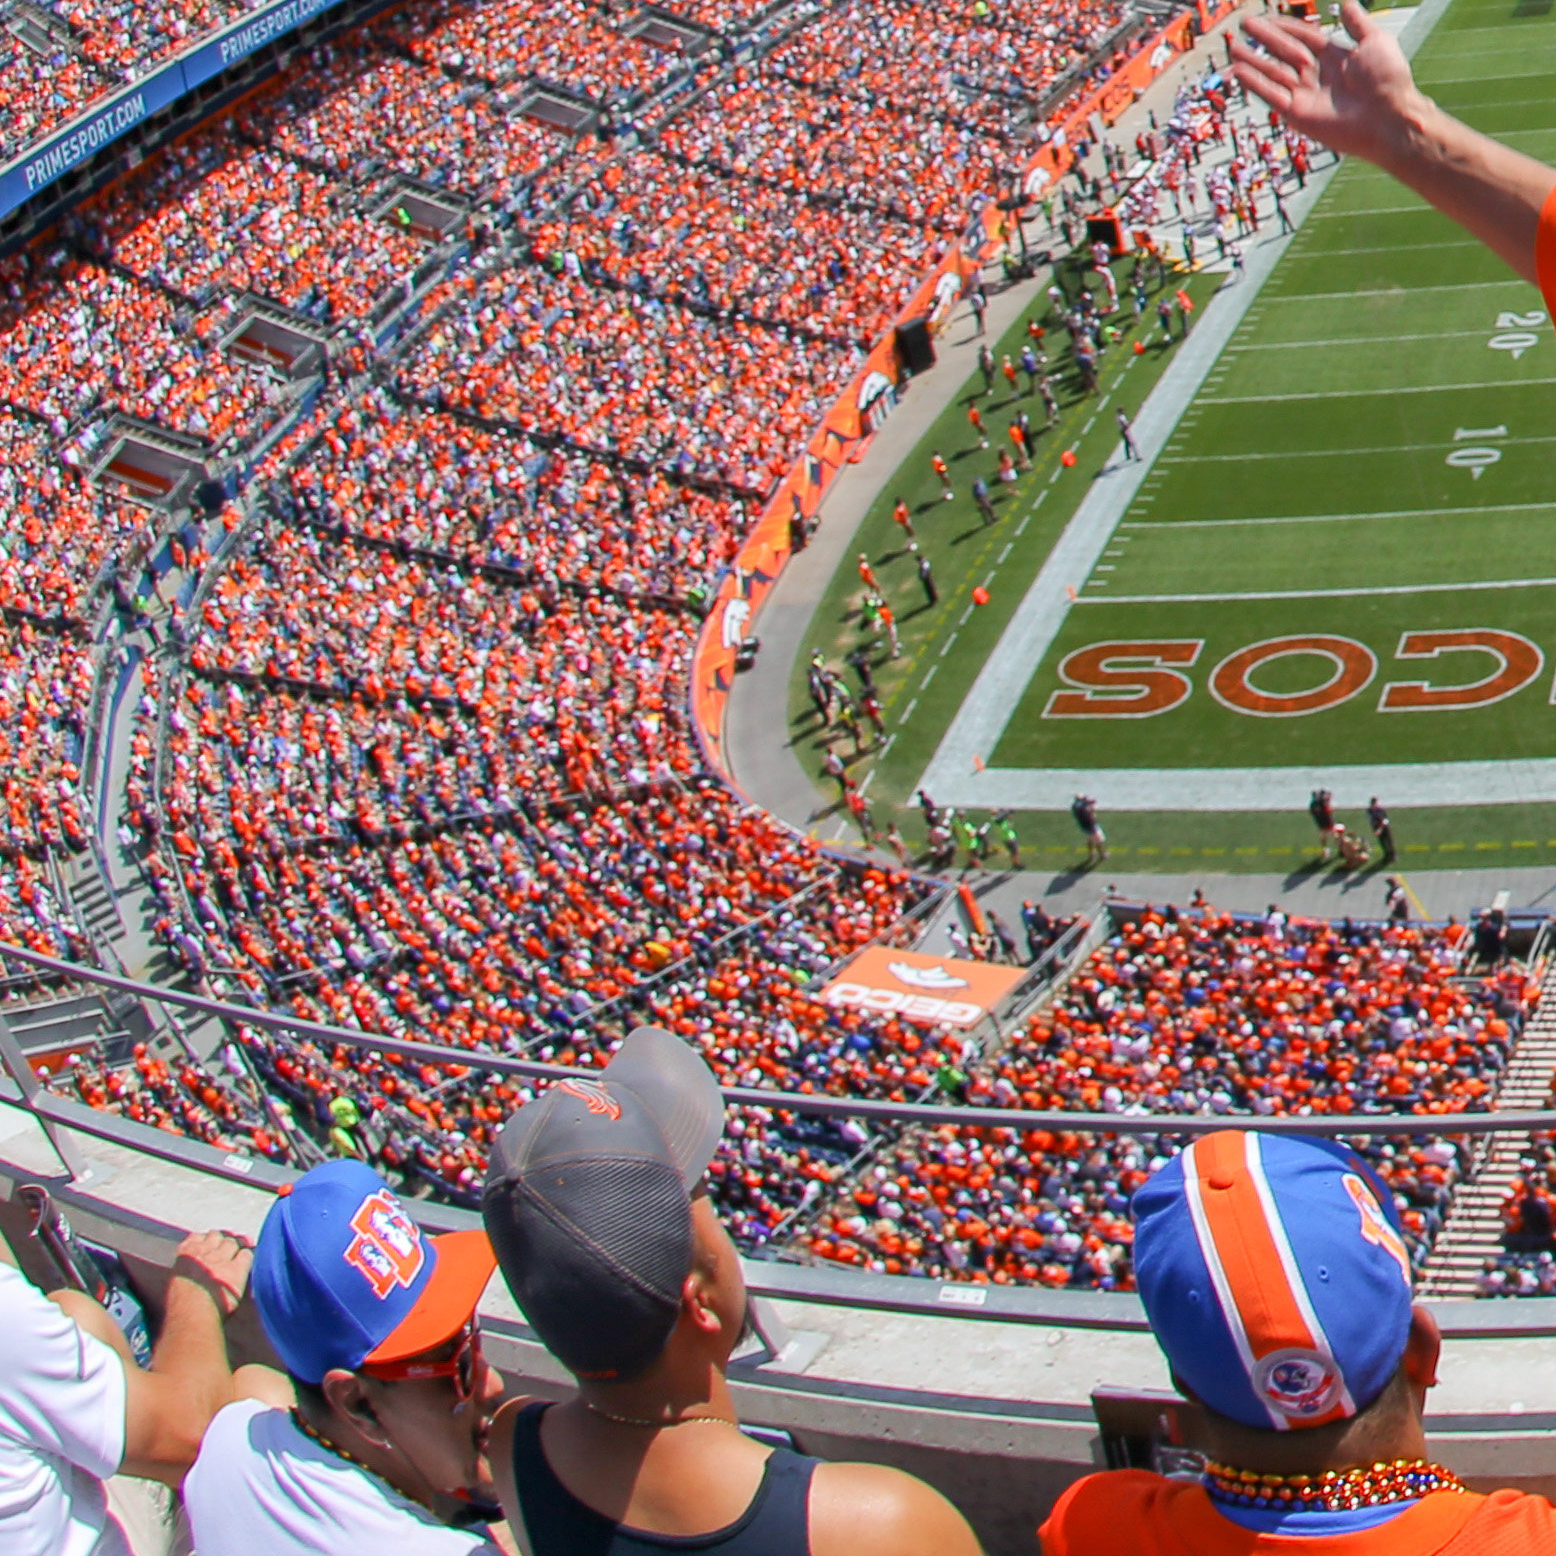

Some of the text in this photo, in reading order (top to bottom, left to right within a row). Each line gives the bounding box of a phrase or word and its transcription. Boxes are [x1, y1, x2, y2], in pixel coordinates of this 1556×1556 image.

[25, 93, 147, 191] PRIMESPORT.COM
[1487, 310, 1547, 350] 20
[1445, 424, 1509, 467] 10
[826, 981, 984, 1025] GEICO
